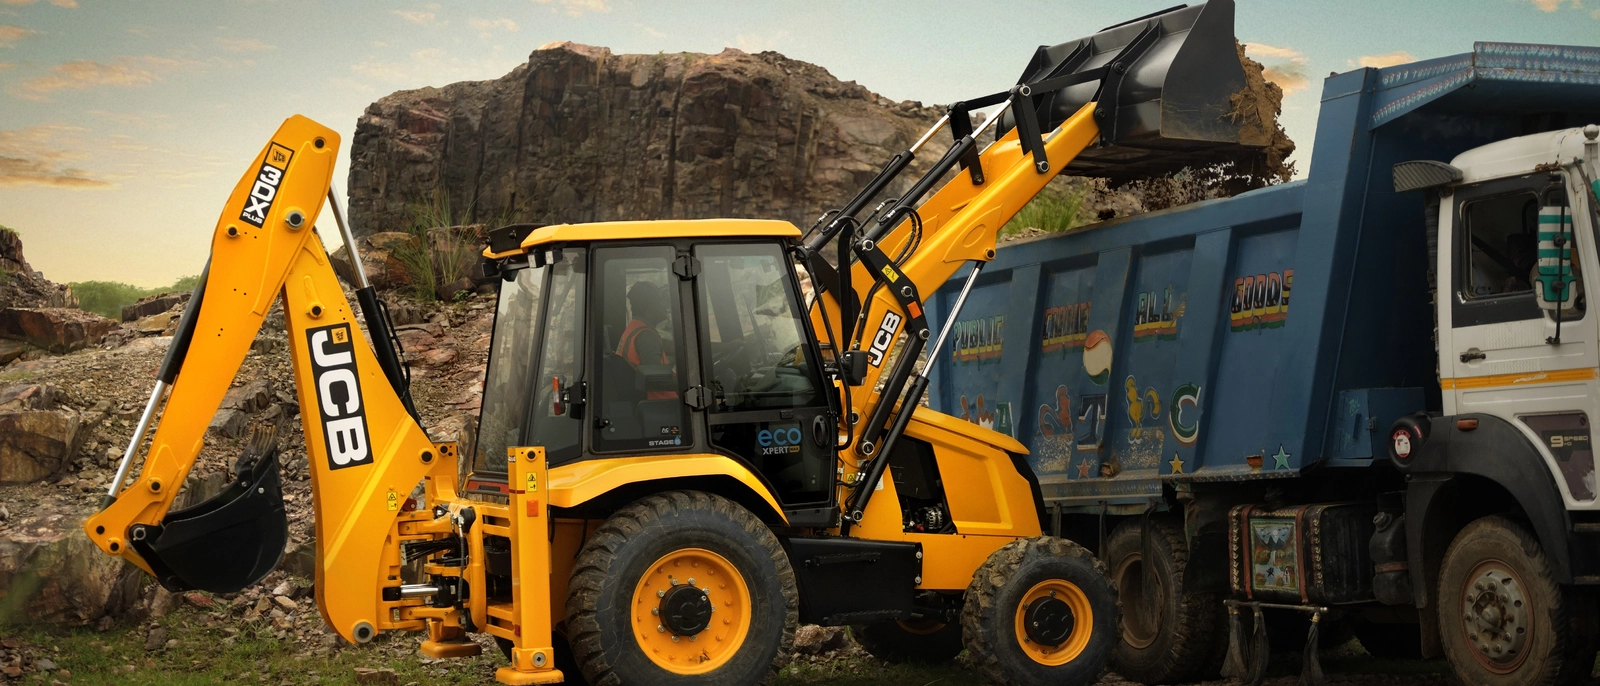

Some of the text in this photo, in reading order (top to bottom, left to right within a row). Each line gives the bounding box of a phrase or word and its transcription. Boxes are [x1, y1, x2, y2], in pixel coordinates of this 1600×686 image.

[273, 150, 286, 163] JCB
[244, 165, 282, 219] 3DX
[242, 211, 264, 224] PLUS
[1231, 268, 1294, 314] GOODS
[869, 312, 901, 366] JCB
[311, 330, 368, 466] JCB
[648, 439, 674, 447] STAGE
[757, 427, 802, 447] eco
[1550, 435, 1564, 448] 9
[762, 446, 789, 456] XPERT
